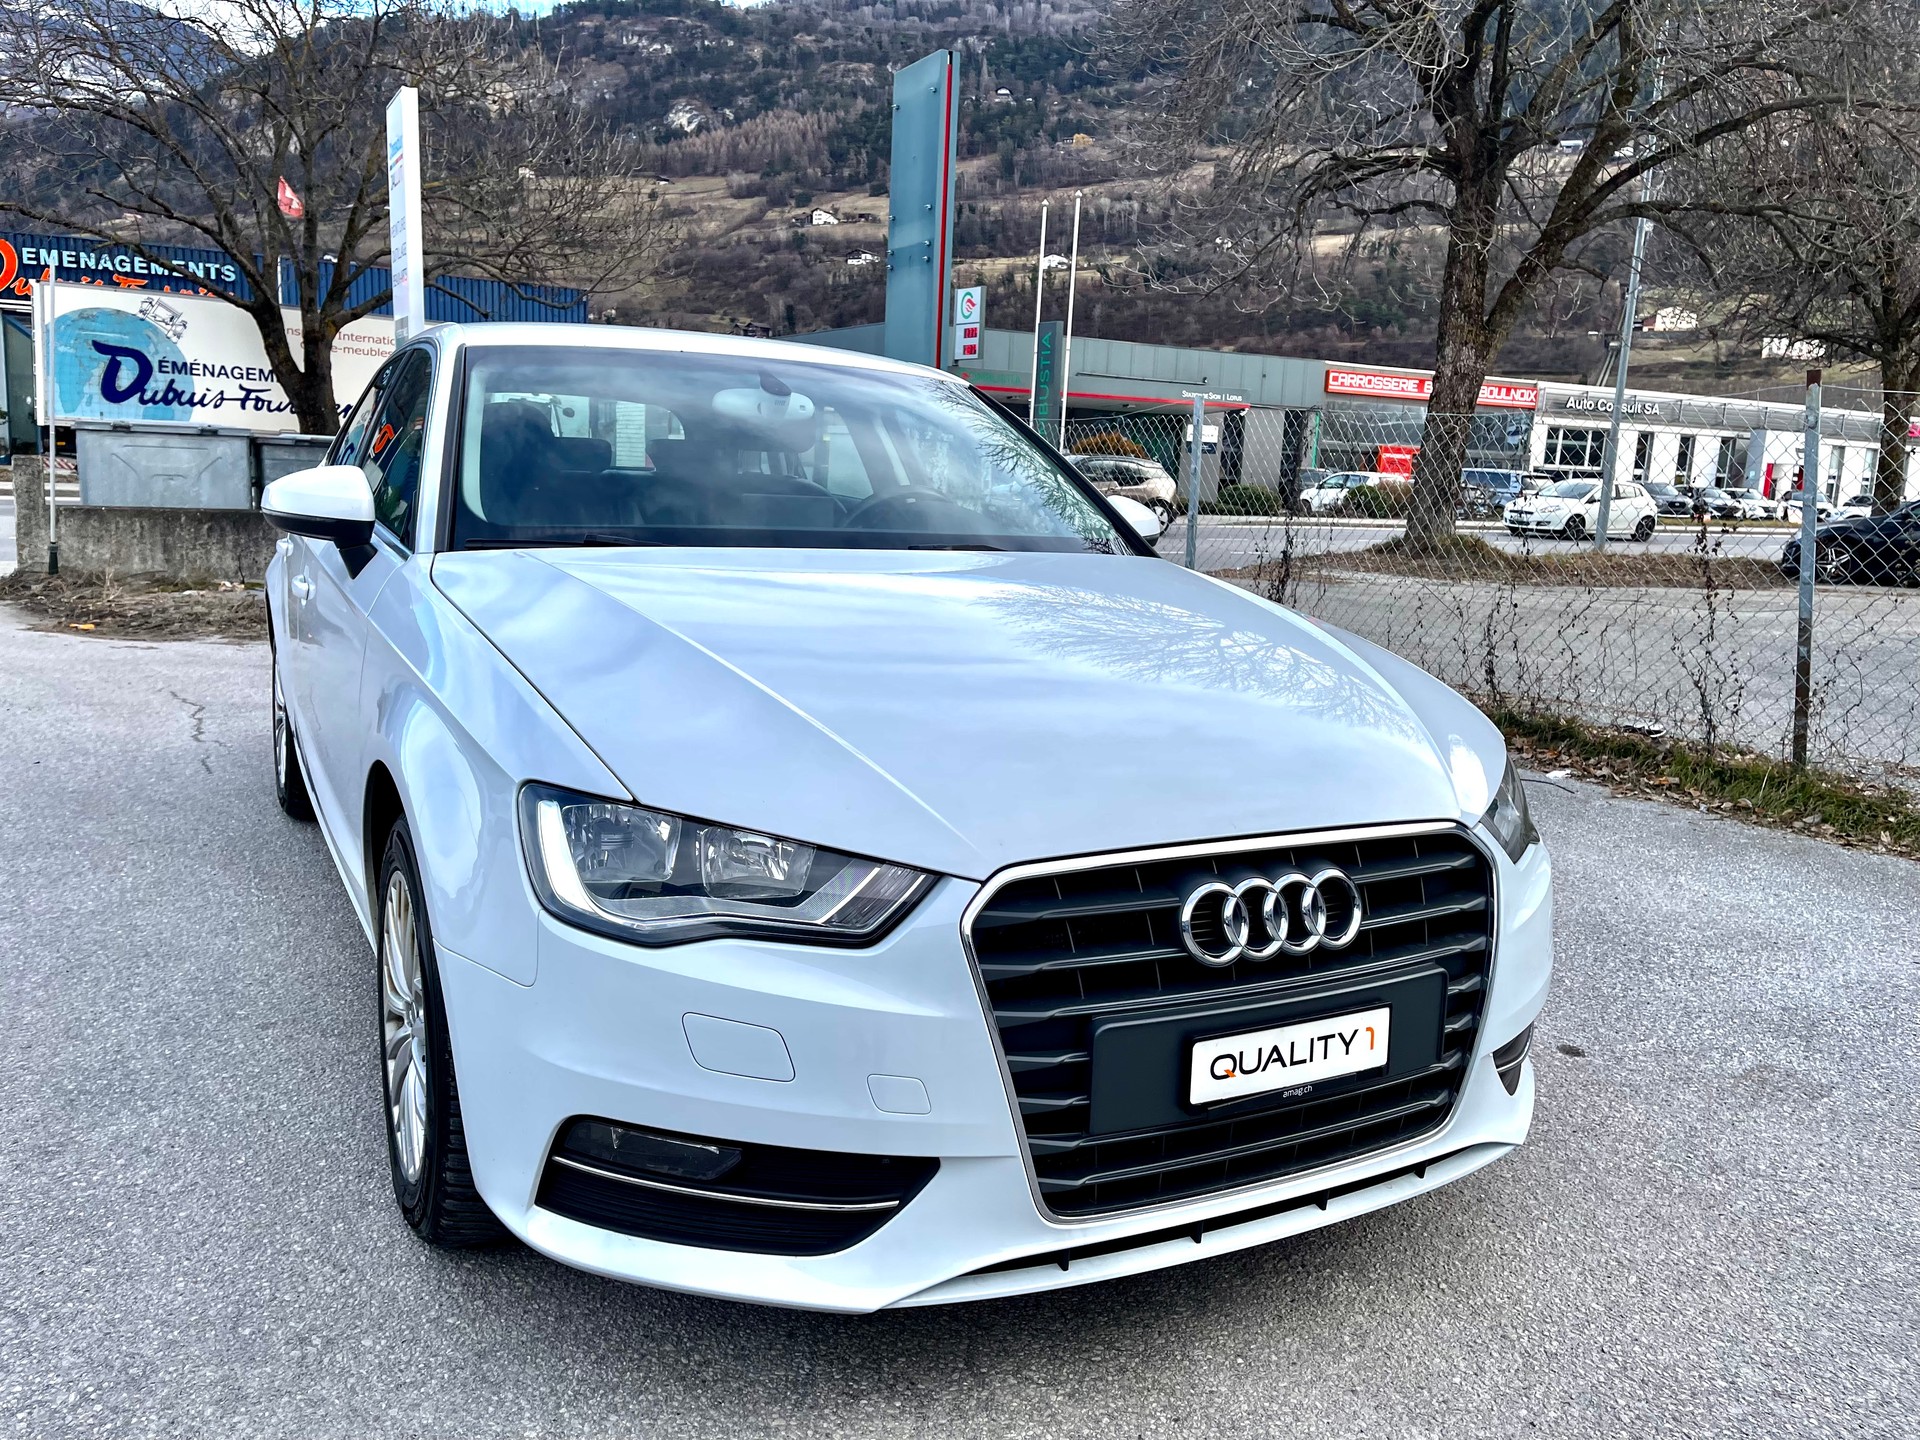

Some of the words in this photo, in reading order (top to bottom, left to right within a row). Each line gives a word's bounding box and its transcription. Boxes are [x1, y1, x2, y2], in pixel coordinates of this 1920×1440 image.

[1328, 371, 1419, 393] CARROSSERIE
[1479, 385, 1537, 402] BOULNOIX
[1566, 396, 1594, 410] Auto
[1597, 398, 1641, 413] Cosult
[1644, 402, 1660, 415] SA
[1282, 1084, 1313, 1098] amag.ch
